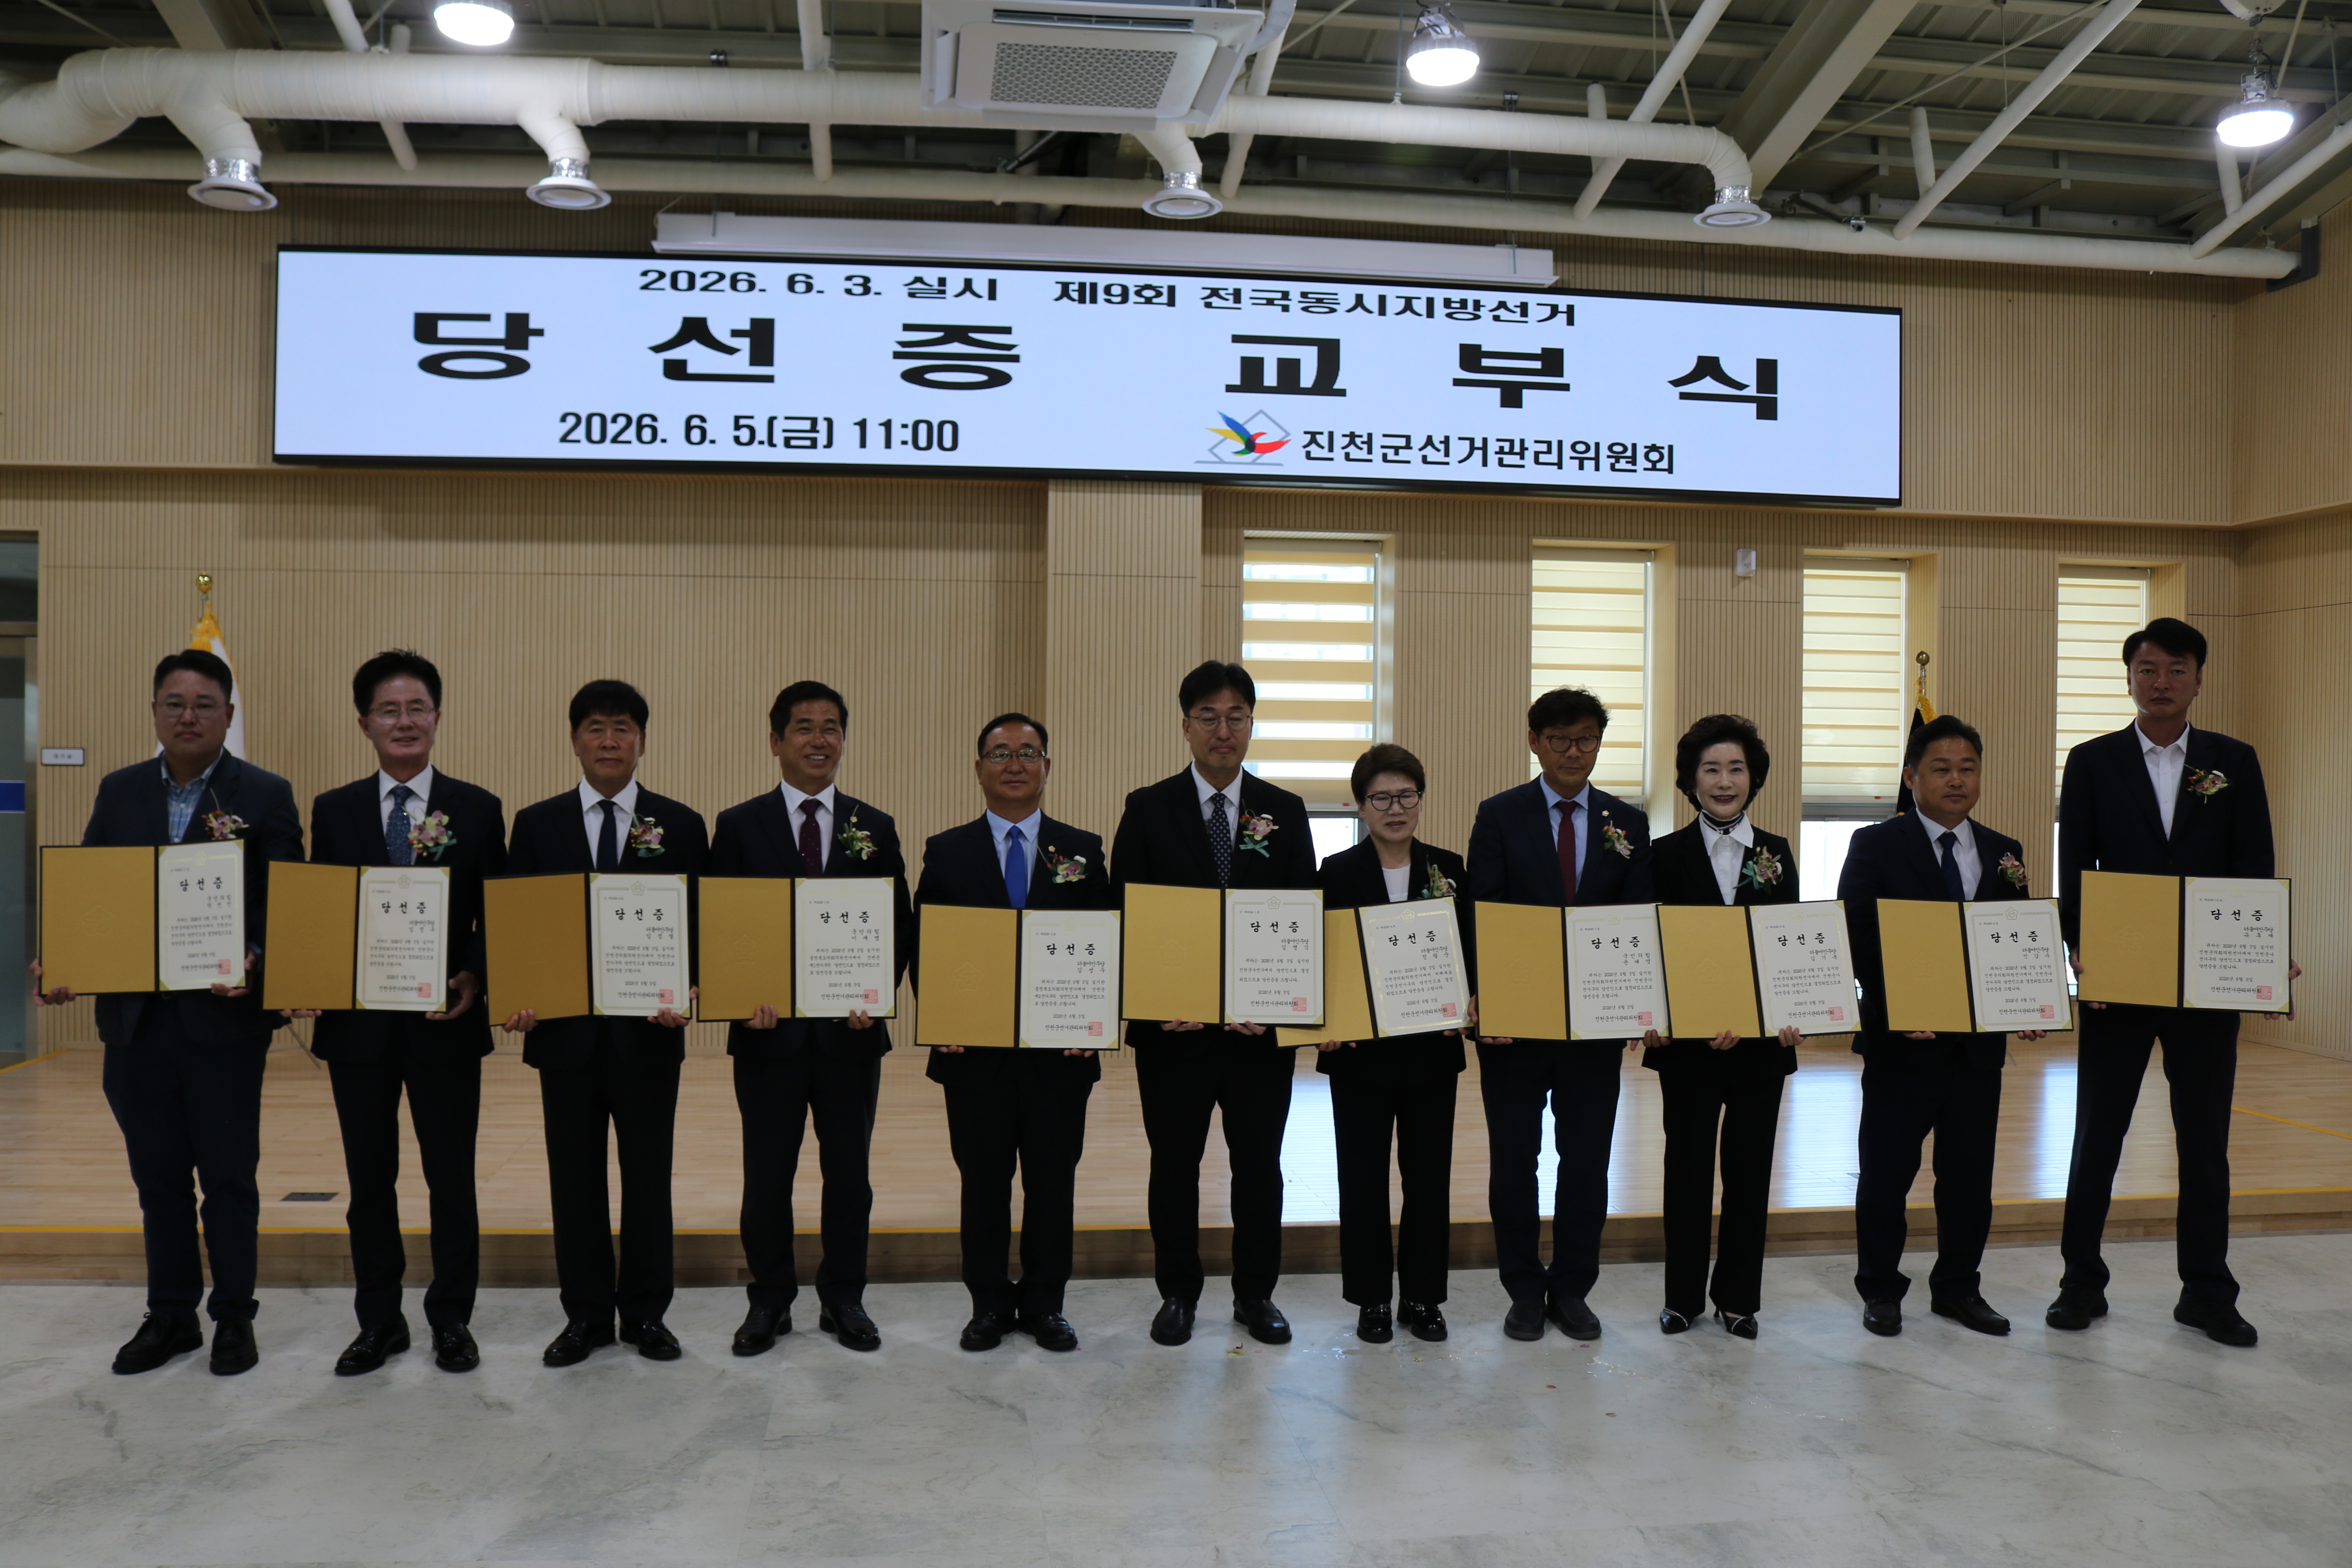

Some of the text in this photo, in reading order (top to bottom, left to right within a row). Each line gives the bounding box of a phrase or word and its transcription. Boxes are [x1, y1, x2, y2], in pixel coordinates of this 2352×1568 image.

[640, 270, 1580, 326] 2026. 6. 3. 실시 제9회 전국동시지방선거
[560, 412, 958, 451] 2026. 6. 5.(금) 11:00
[1299, 431, 1673, 476] 진천군선거관리위원회
